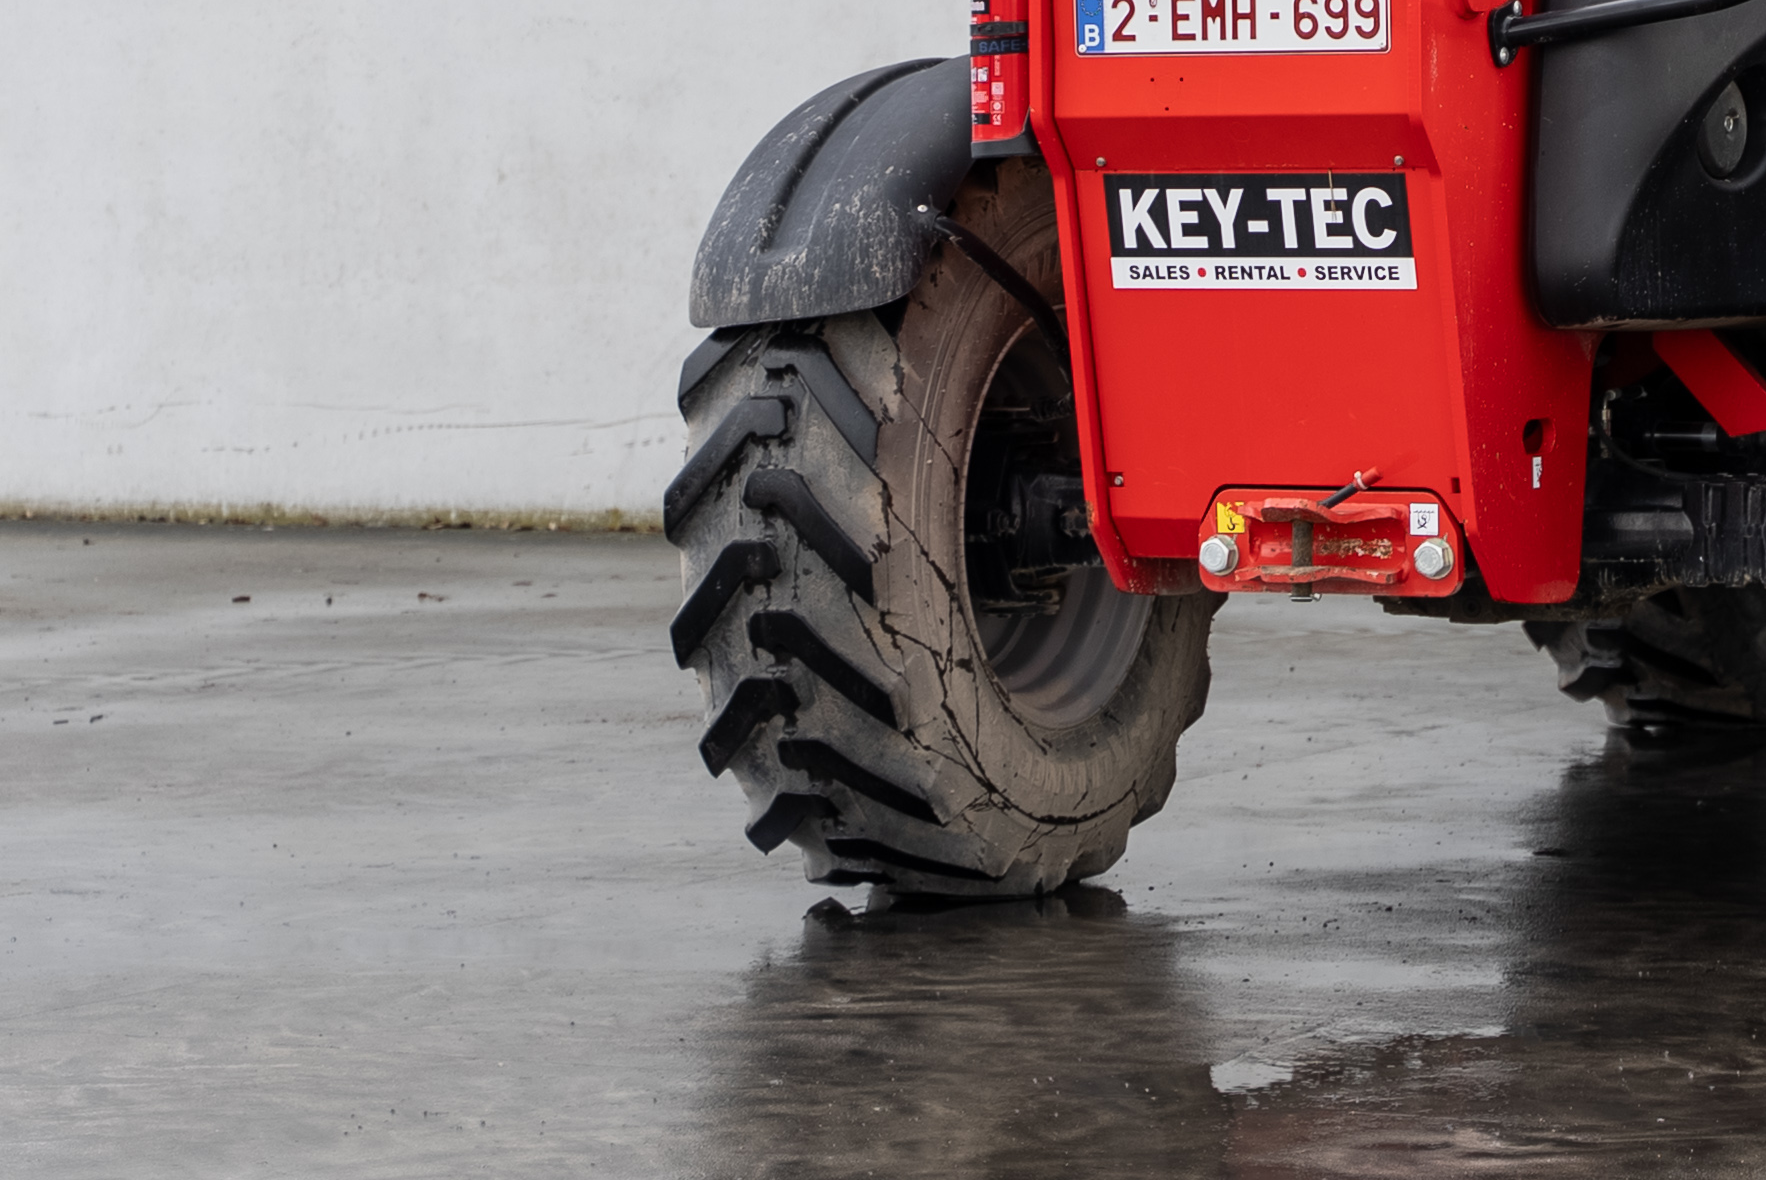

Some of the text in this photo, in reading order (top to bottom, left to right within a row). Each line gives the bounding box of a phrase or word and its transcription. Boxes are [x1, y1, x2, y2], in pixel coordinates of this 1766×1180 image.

[1084, 24, 1100, 47] B
[1119, 187, 1397, 250] KEY-TEC
[1129, 265, 1400, 281] SALES RENTAL SERVICE
